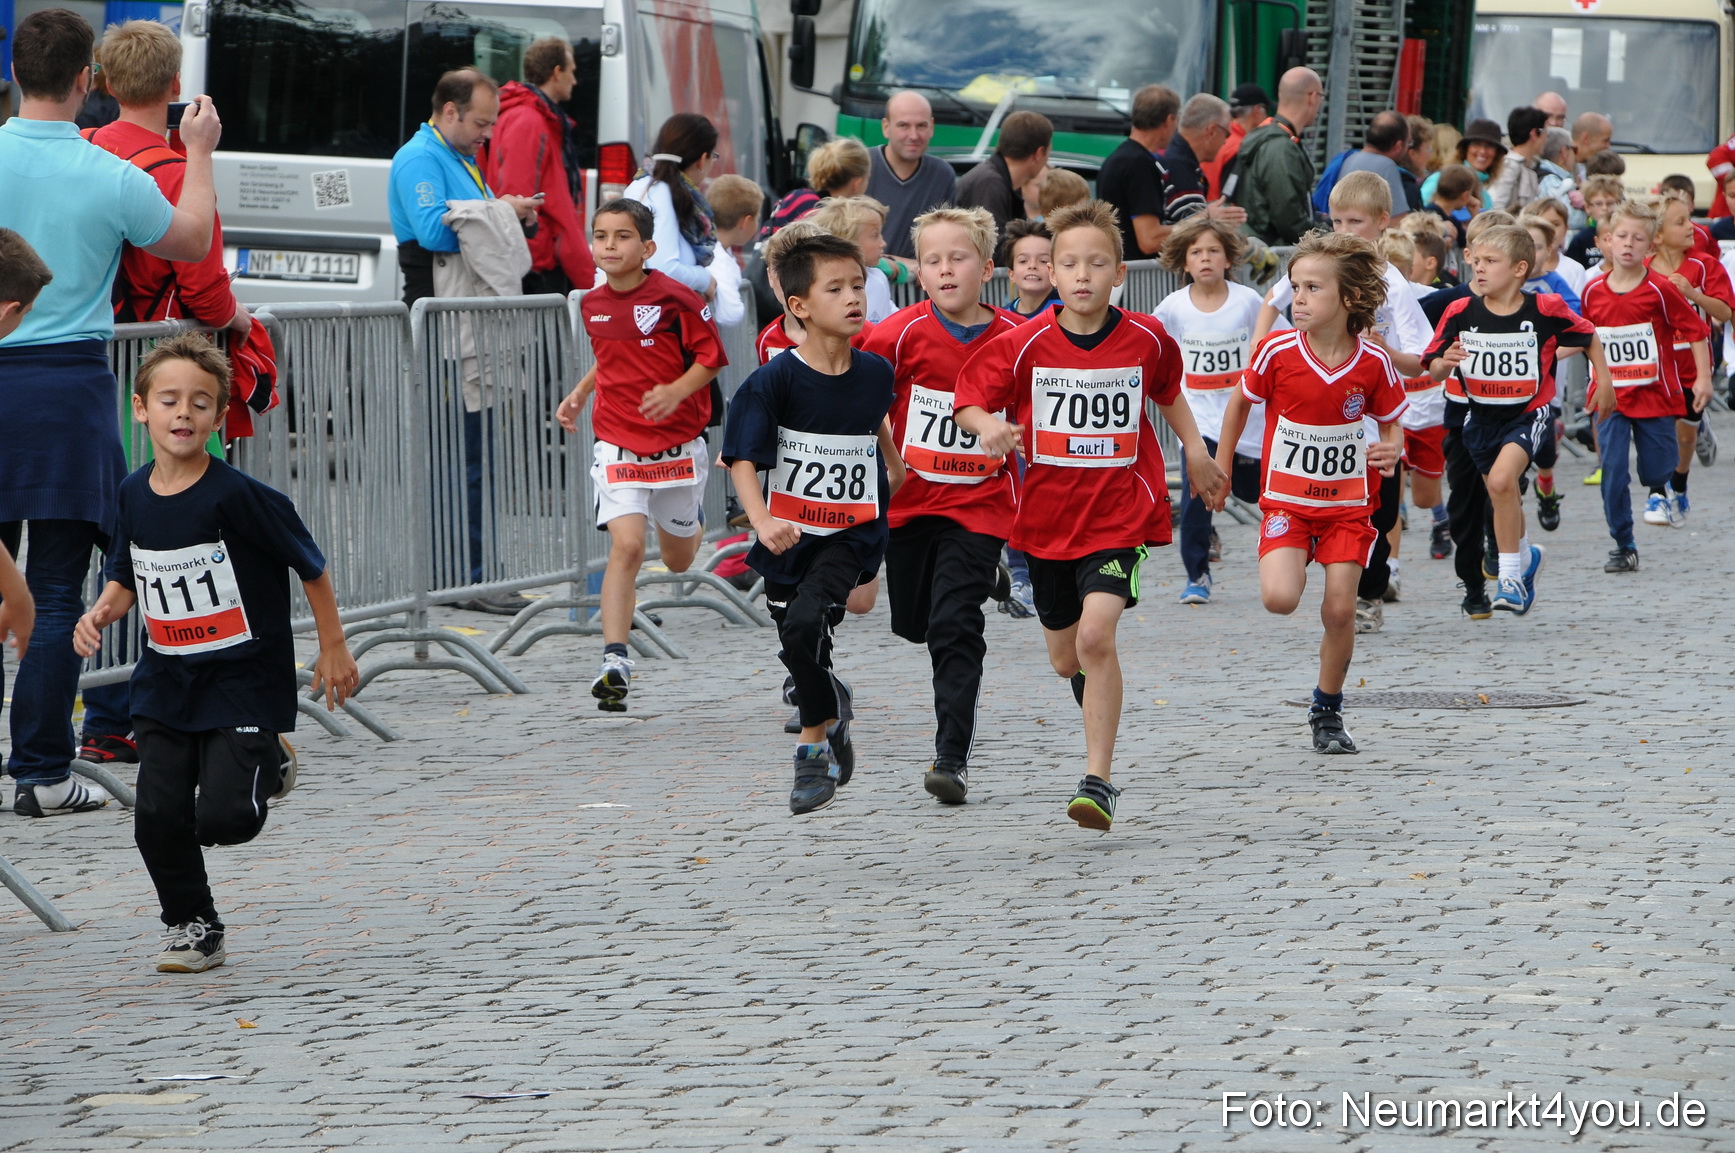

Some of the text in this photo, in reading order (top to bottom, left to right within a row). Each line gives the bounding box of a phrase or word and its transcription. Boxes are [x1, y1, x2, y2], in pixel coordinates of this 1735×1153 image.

[250, 253, 354, 275] NM YV 1111
[641, 339, 654, 347] MD
[1183, 337, 1239, 347] PARTL Neumarkt
[1462, 338, 1484, 348] PARTL
[1610, 331, 1643, 340] Neumarkt
[1189, 346, 1241, 373] 7391
[1468, 350, 1529, 376] 7085
[1036, 378, 1125, 389] PARTL Neumarkt
[1404, 381, 1426, 390] bian
[1481, 383, 1514, 395] Kilian
[913, 394, 945, 410] PARTL
[1046, 391, 1130, 429] 7099
[921, 410, 980, 449] 709
[1278, 424, 1353, 443] PARTL Neumarkt
[778, 437, 863, 456] PARTL Neumarkt
[1066, 439, 1105, 455] Lauri
[933, 456, 975, 472] Lukas
[1283, 440, 1356, 476] 7088
[616, 466, 685, 479] Maximilian
[783, 457, 866, 500] 7238
[1304, 483, 1329, 497] Jan
[799, 505, 846, 524] Julian
[133, 557, 207, 573] RTL Neumarkt
[136, 570, 220, 614] 7111
[163, 625, 205, 642] Timo
